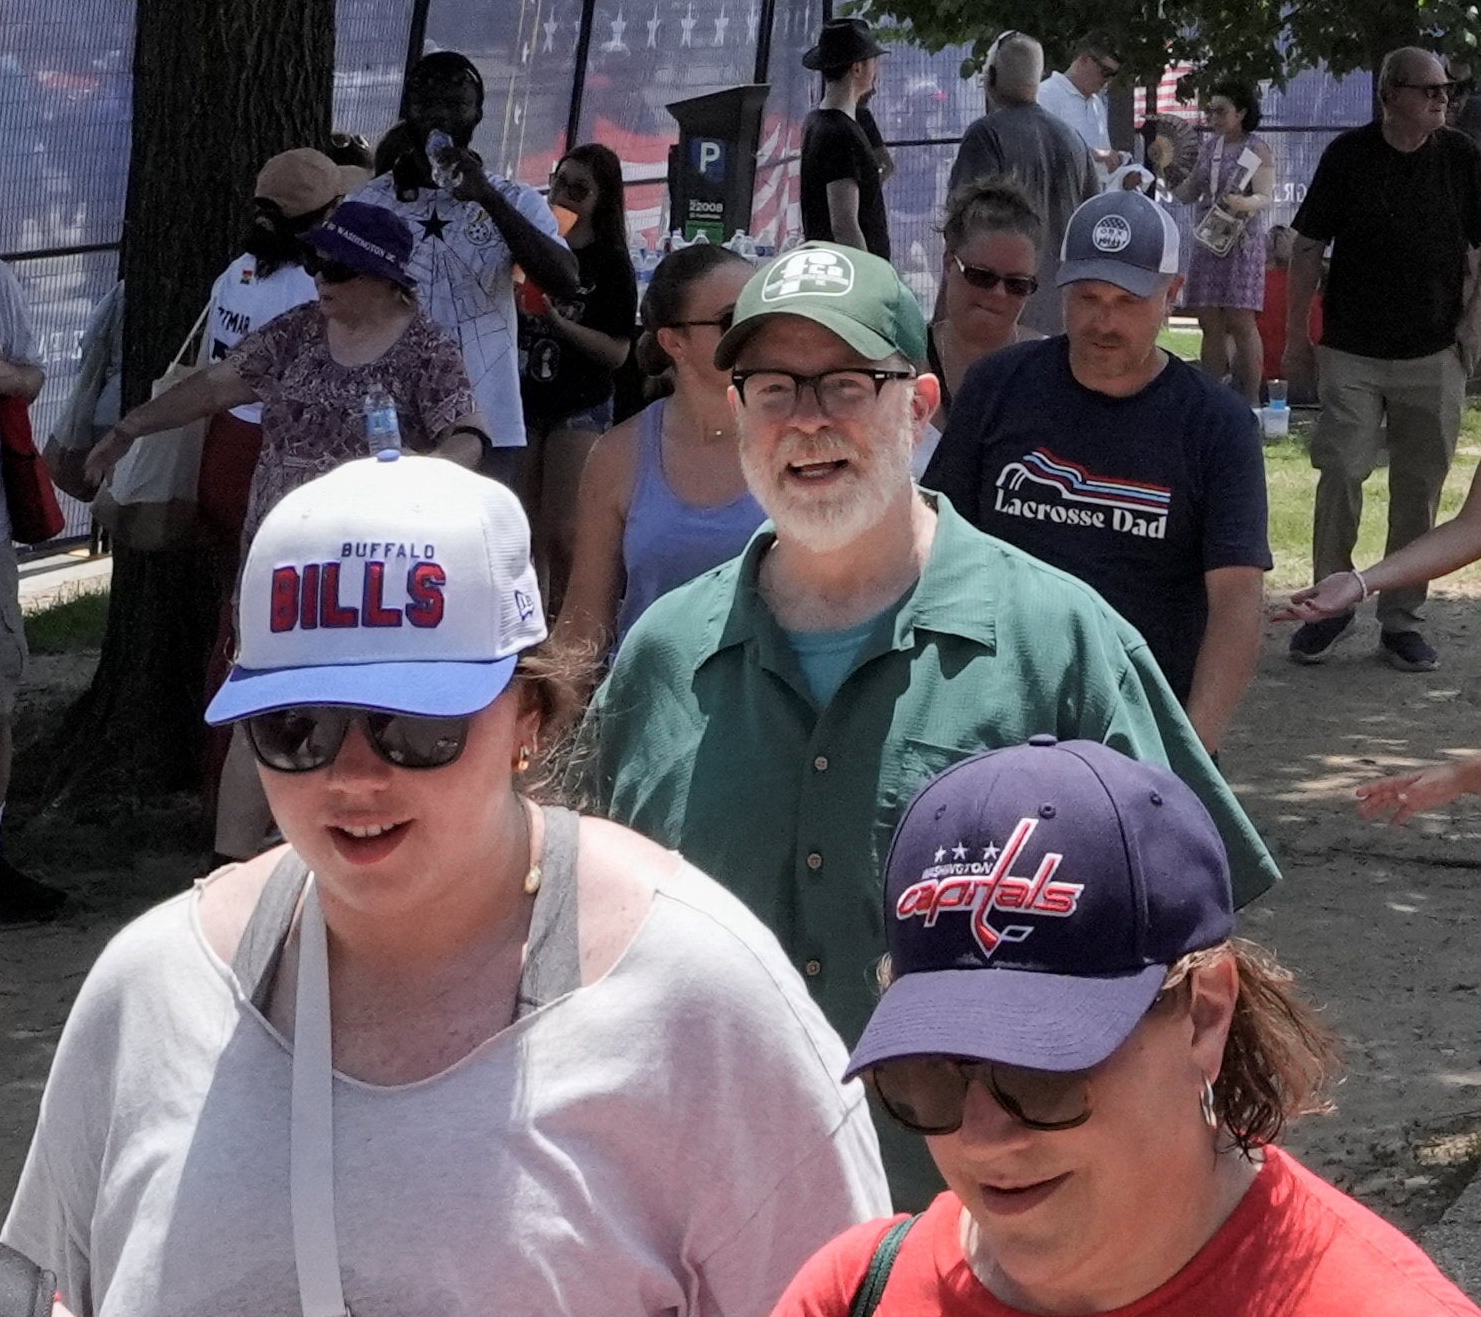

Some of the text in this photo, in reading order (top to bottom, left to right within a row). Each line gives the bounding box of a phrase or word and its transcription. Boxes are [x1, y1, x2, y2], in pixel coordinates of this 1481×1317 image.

[699, 141, 721, 174] P
[994, 487, 1168, 540] Lacrosse Dad
[341, 542, 435, 559] BUFFALO
[269, 560, 446, 633] BILLS
